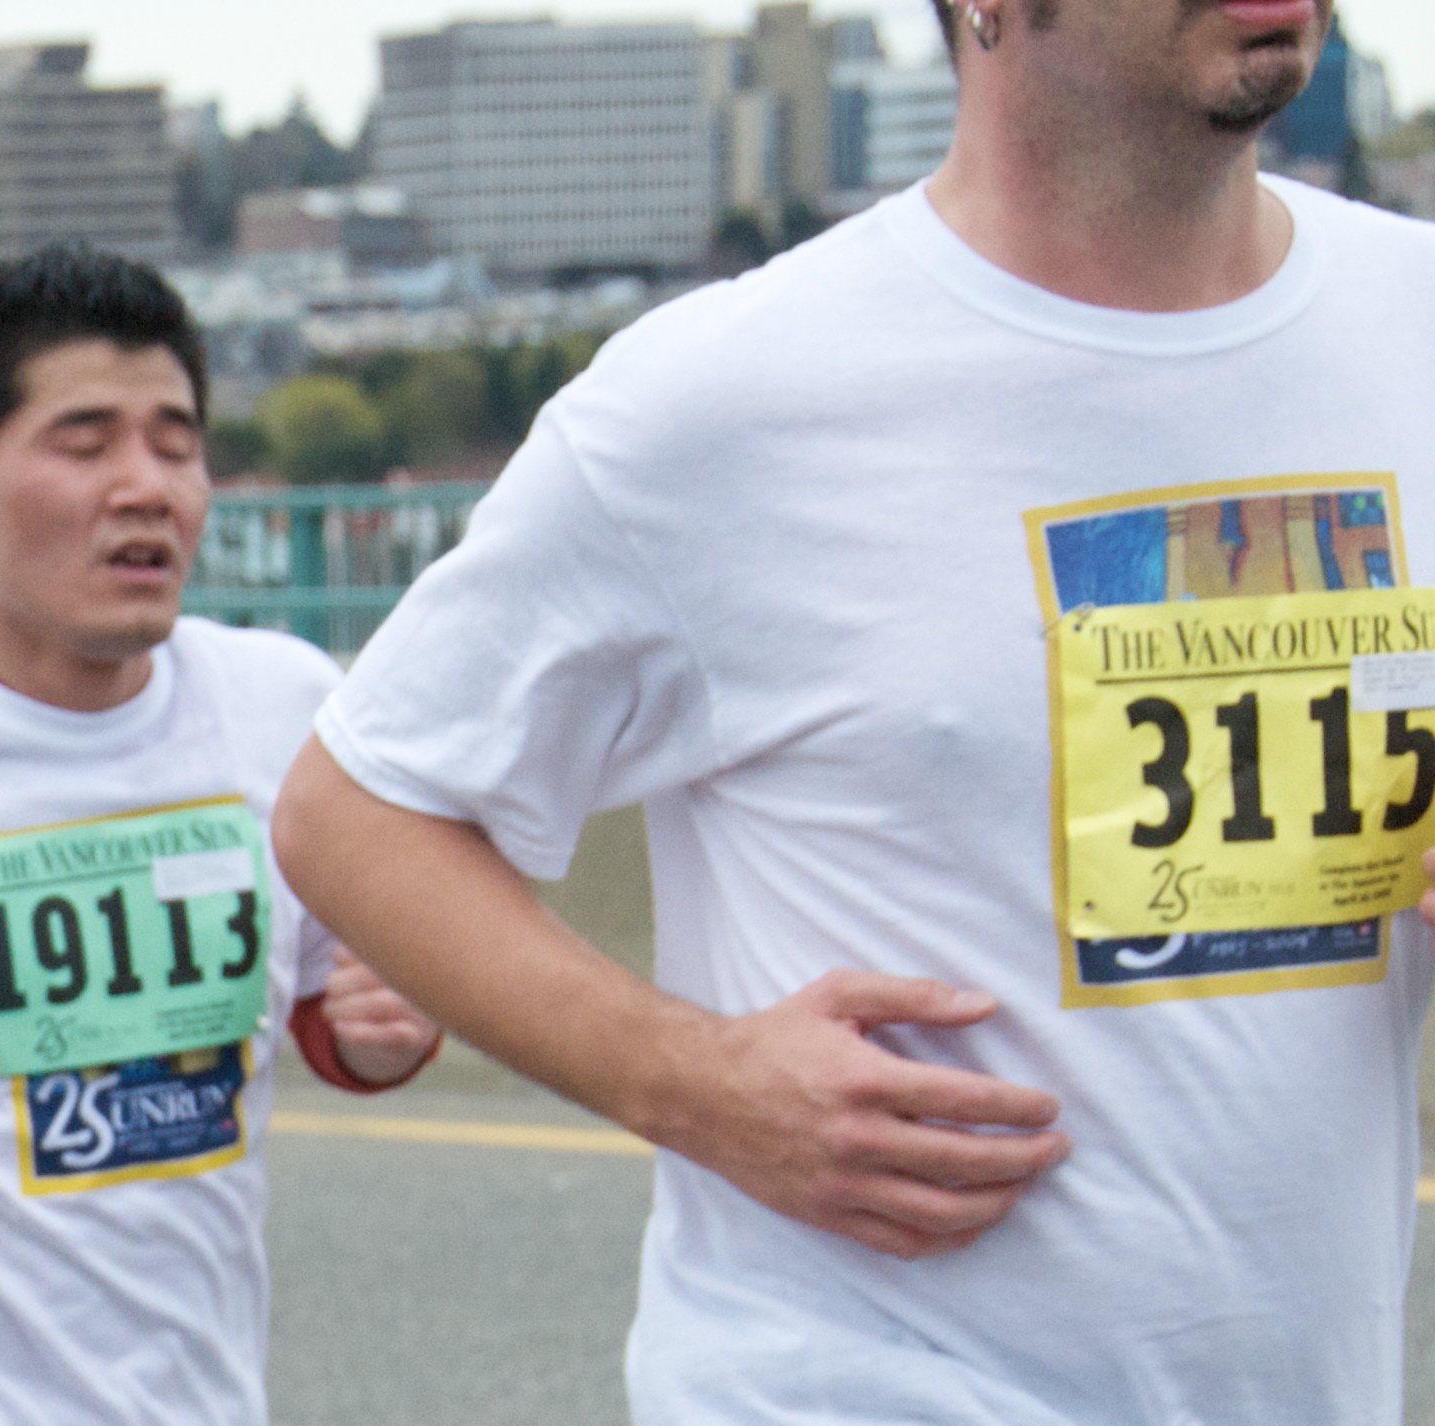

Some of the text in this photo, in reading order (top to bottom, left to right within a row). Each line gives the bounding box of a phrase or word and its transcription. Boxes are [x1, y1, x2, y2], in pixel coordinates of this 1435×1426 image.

[1091, 603, 1435, 673] THE VANCOUVER SU
[1125, 686, 1435, 849] 3115
[35, 829, 184, 873] VANCOUVER
[189, 820, 246, 850] SUN
[1148, 857, 1207, 924] 25
[36, 1072, 121, 1169] 25
